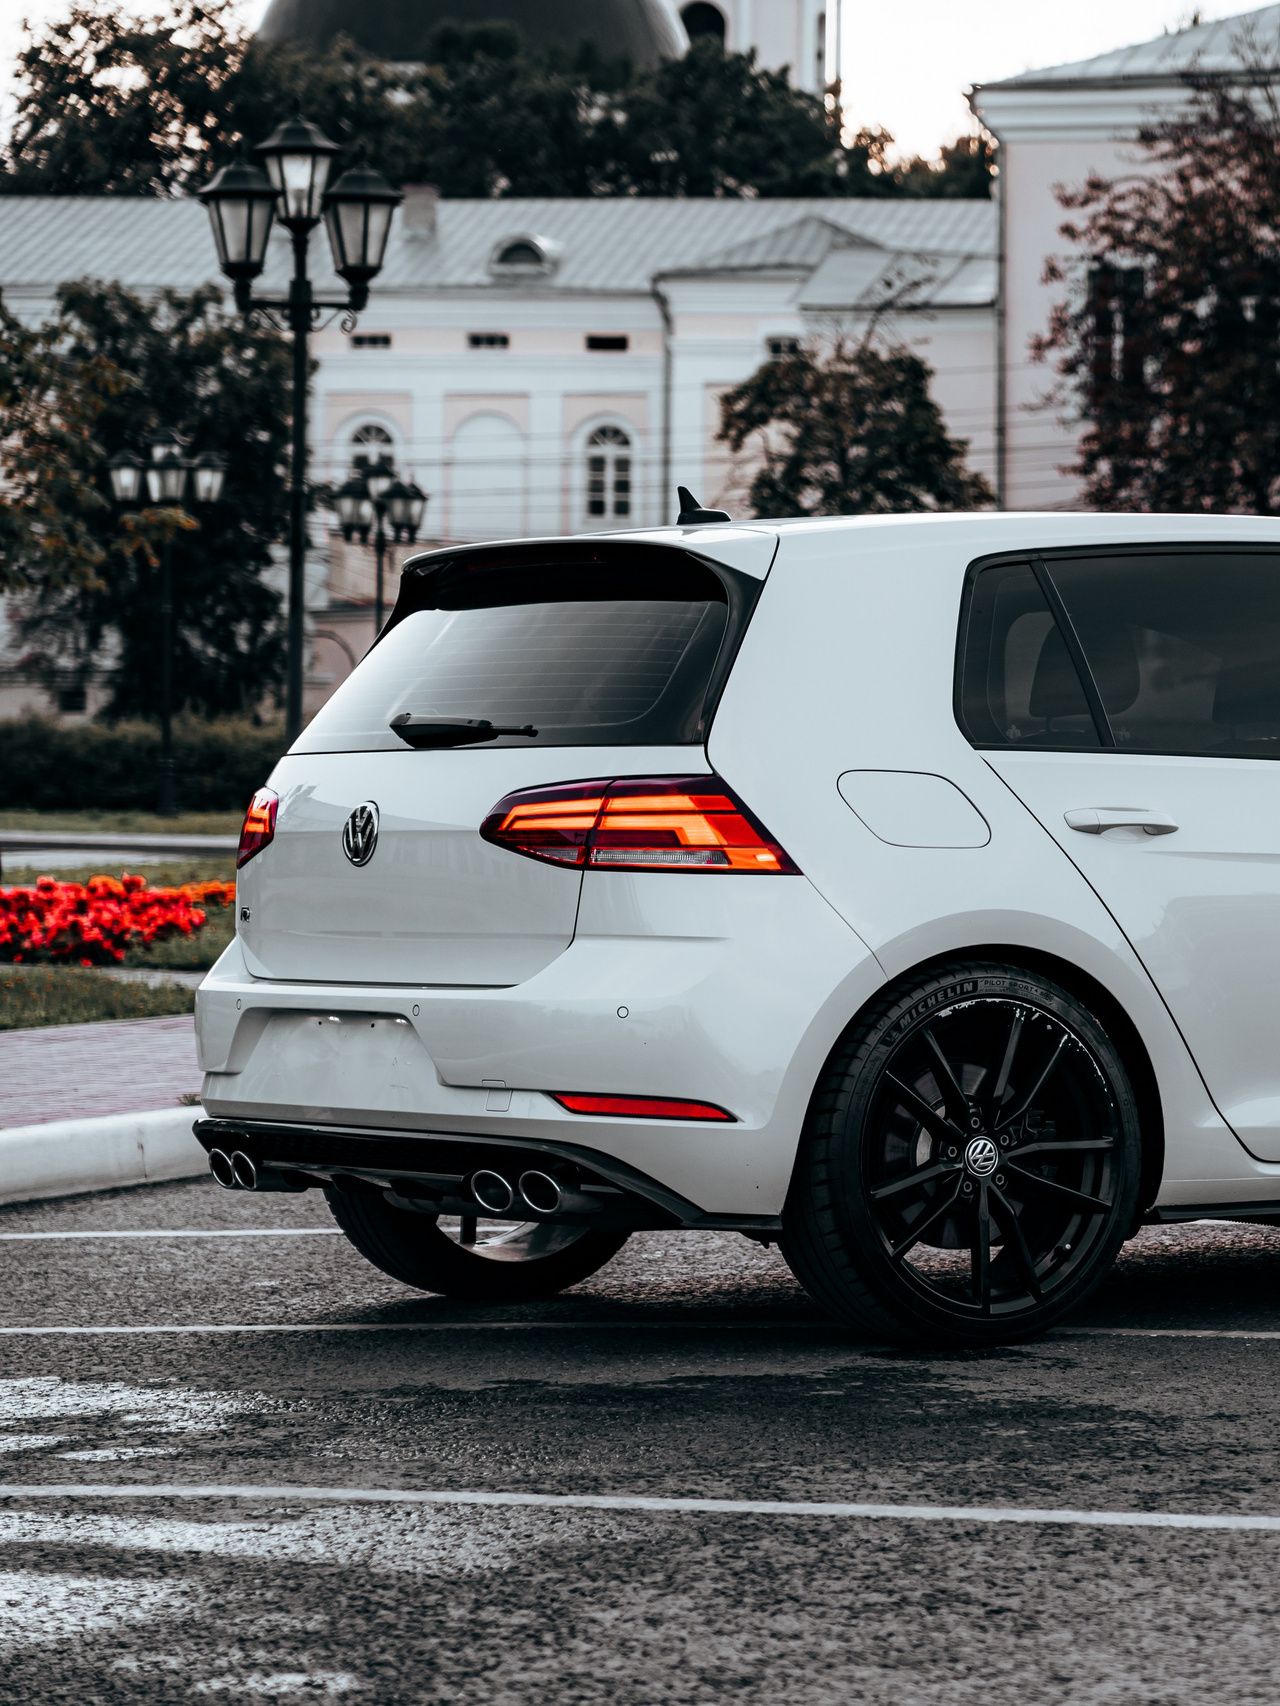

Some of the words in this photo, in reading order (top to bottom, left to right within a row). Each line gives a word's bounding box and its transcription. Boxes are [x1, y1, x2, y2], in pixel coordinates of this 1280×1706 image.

[342, 800, 379, 867] VW
[898, 981, 974, 1030] MICHELIN
[1008, 982, 1034, 991] SPORT
